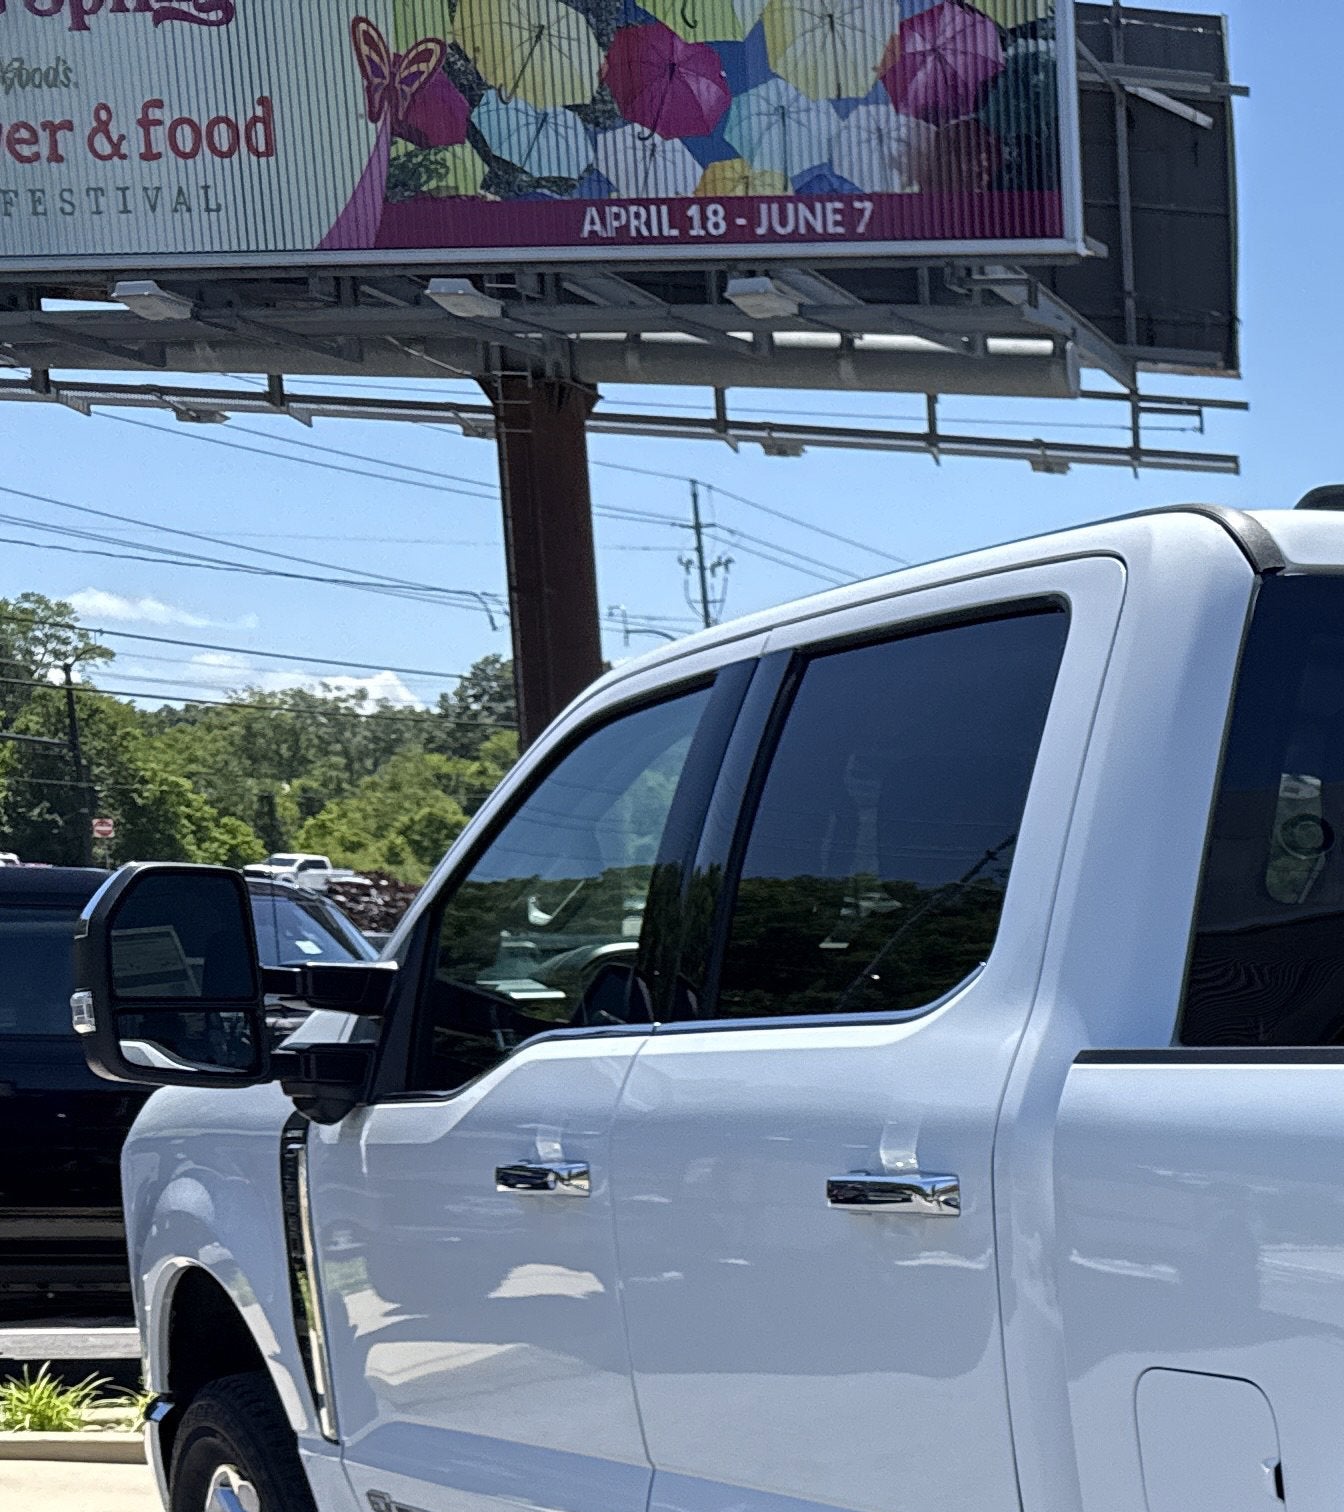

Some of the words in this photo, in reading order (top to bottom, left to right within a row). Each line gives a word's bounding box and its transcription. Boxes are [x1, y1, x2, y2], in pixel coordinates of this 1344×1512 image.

[0, 119, 74, 164] er
[87, 102, 129, 162] &
[136, 95, 275, 162] food
[0, 185, 222, 217] FESTIVAL
[580, 203, 680, 238] APRIL
[686, 203, 727, 237] 18
[755, 202, 846, 236] JUNE
[853, 201, 874, 234] 7
